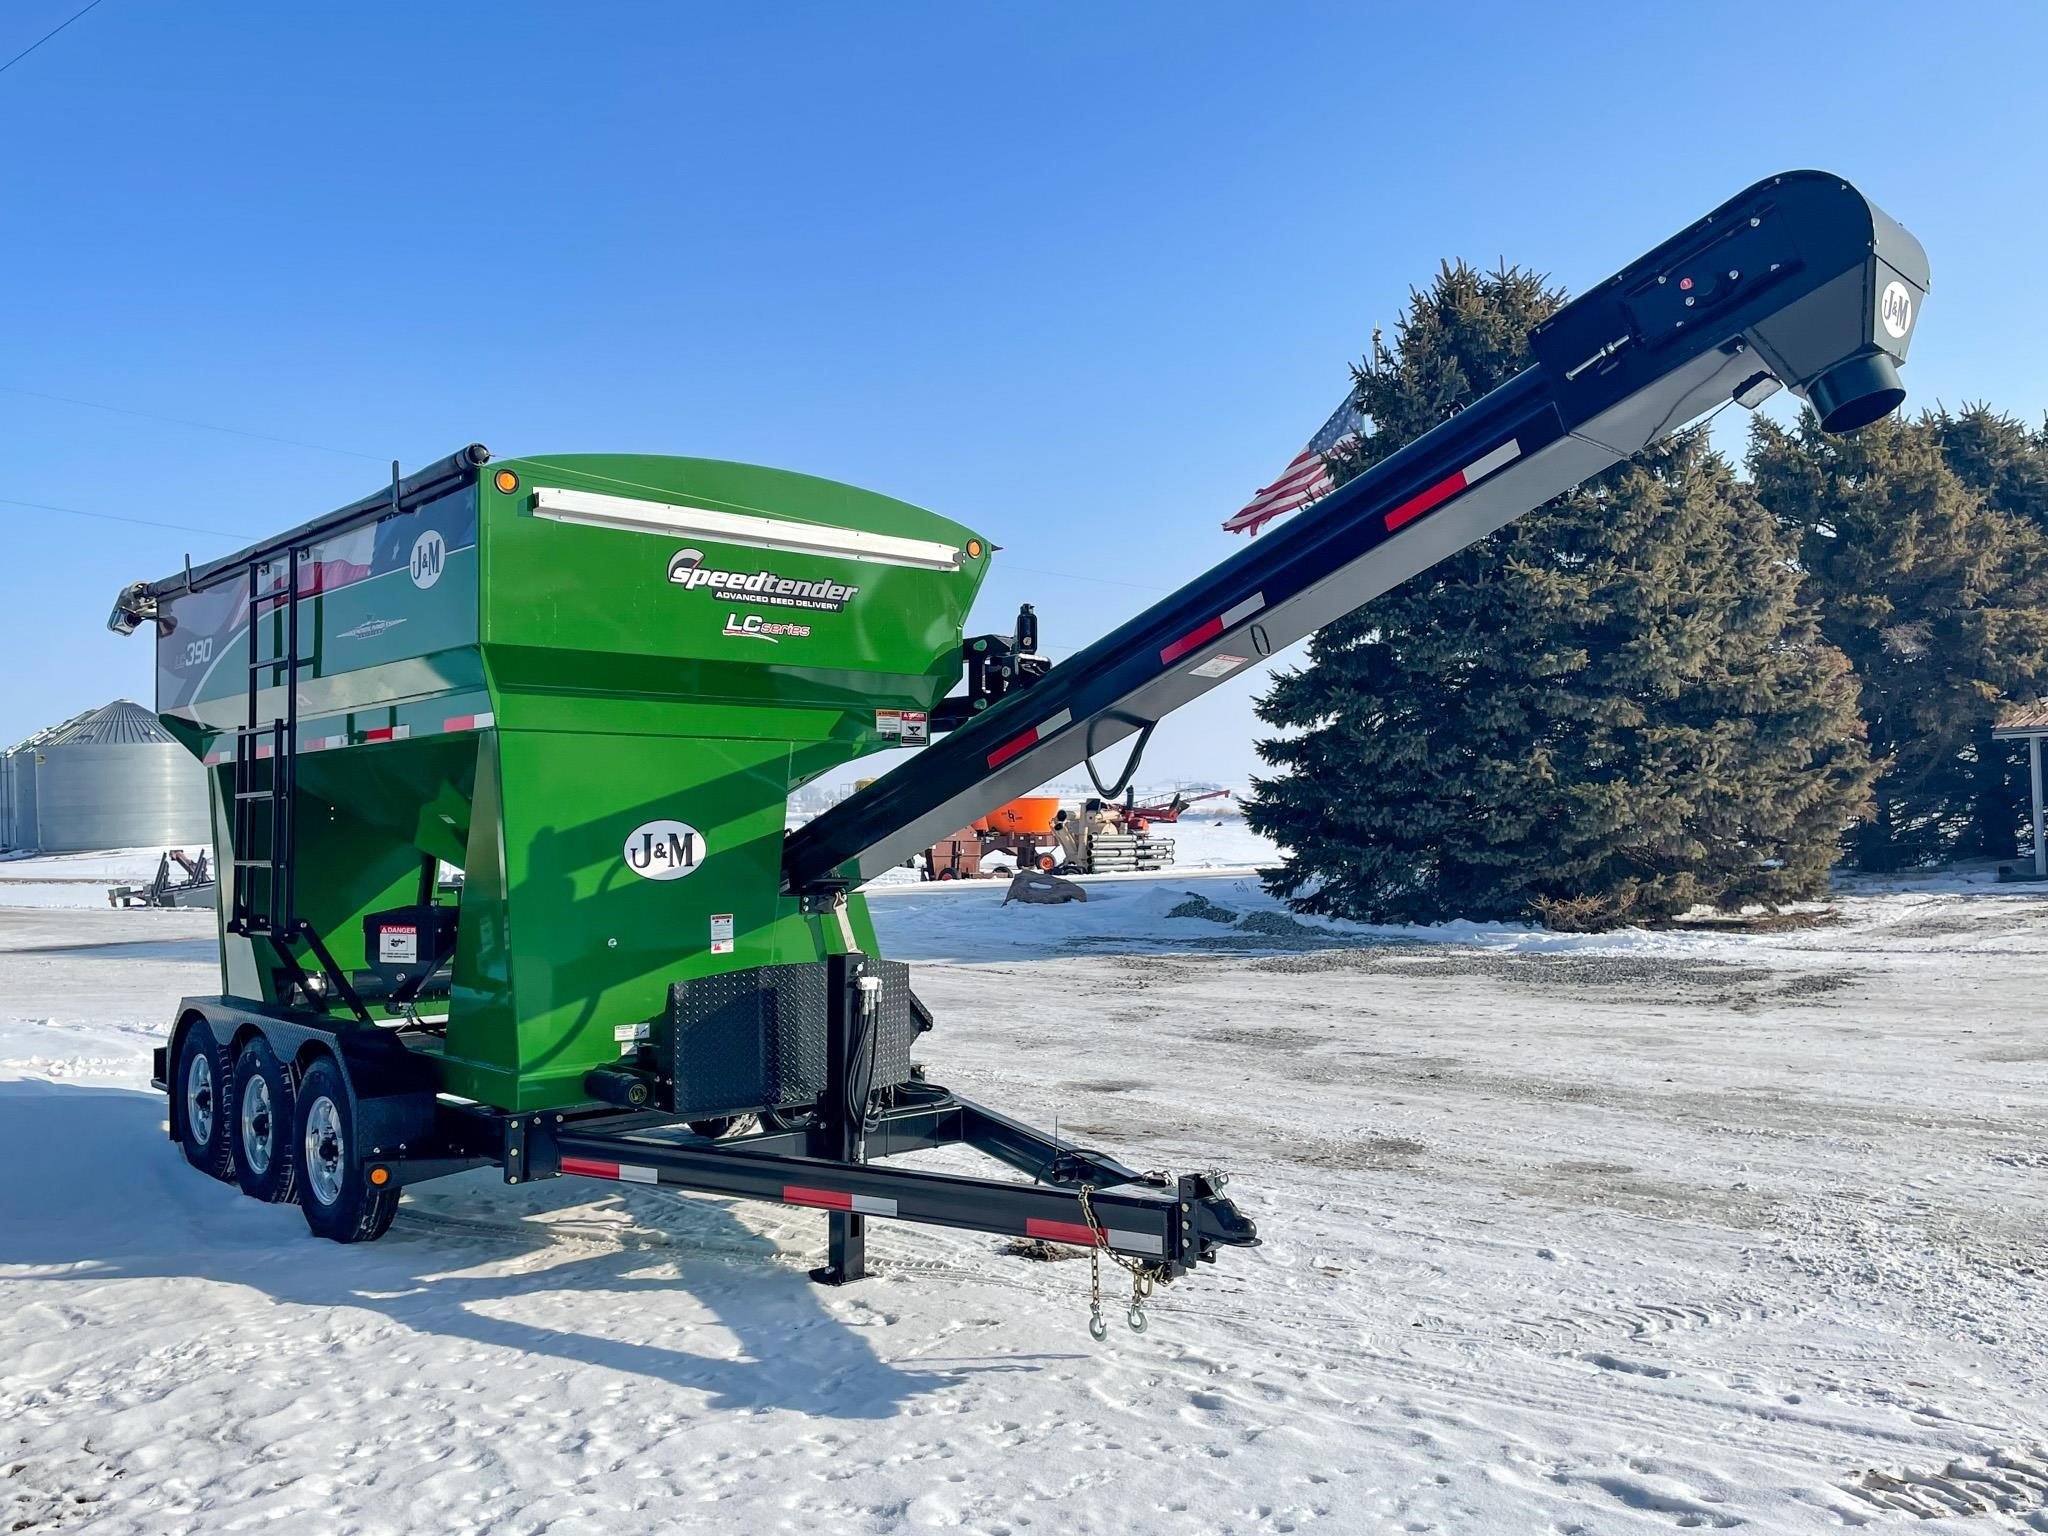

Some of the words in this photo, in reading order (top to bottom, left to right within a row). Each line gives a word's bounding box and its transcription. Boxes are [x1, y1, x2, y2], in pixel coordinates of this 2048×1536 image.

[1883, 289, 1909, 331] J&M
[412, 539, 440, 580] J&M
[715, 591, 769, 603] ADVANCED
[770, 597, 794, 606] SEED
[796, 600, 839, 610] DELIVERY
[630, 832, 694, 869] J&M
